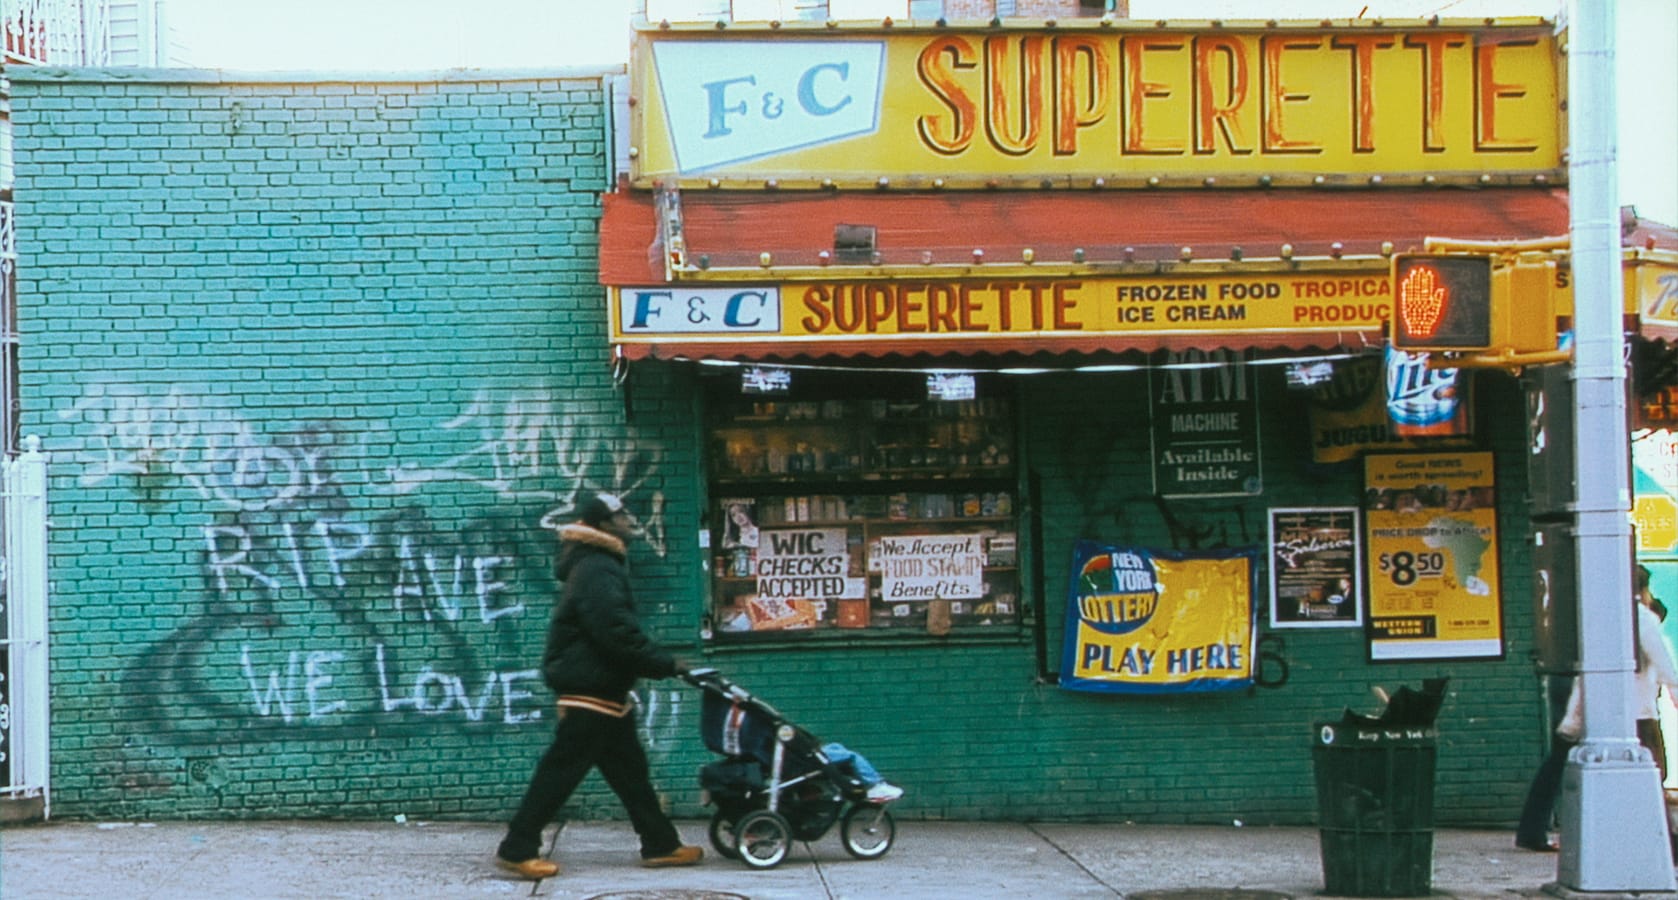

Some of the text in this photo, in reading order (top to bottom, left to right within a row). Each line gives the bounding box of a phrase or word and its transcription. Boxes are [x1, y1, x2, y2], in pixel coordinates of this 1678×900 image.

[702, 62, 852, 139] F & C
[915, 33, 1540, 156] SUPERETTE
[1116, 283, 1281, 302] FROZEN FOOD
[1291, 279, 1391, 298] TROPICA
[629, 291, 767, 328] F & C
[802, 282, 1083, 333] SUPERETTE
[1117, 304, 1246, 323] ICE CREAM
[1293, 303, 1391, 322] PRODUC
[1160, 350, 1248, 403] ATM
[1171, 412, 1240, 432] MACHINE
[1161, 447, 1254, 464] Available
[1177, 466, 1239, 481] Inside
[1372, 528, 1404, 538] PRICE
[1407, 527, 1438, 537] DROP
[771, 532, 824, 555] WIC
[882, 538, 975, 559] We Accept
[758, 556, 843, 576] CHECKS
[1111, 552, 1144, 570] NEW
[394, 535, 525, 623] AVE
[758, 576, 845, 598] ACCEPTED
[890, 580, 970, 598] Benefits
[1114, 570, 1153, 591] YORK
[1082, 642, 1243, 675] PLAY HERE
[240, 645, 347, 724] WE
[376, 643, 543, 724] LOVE
